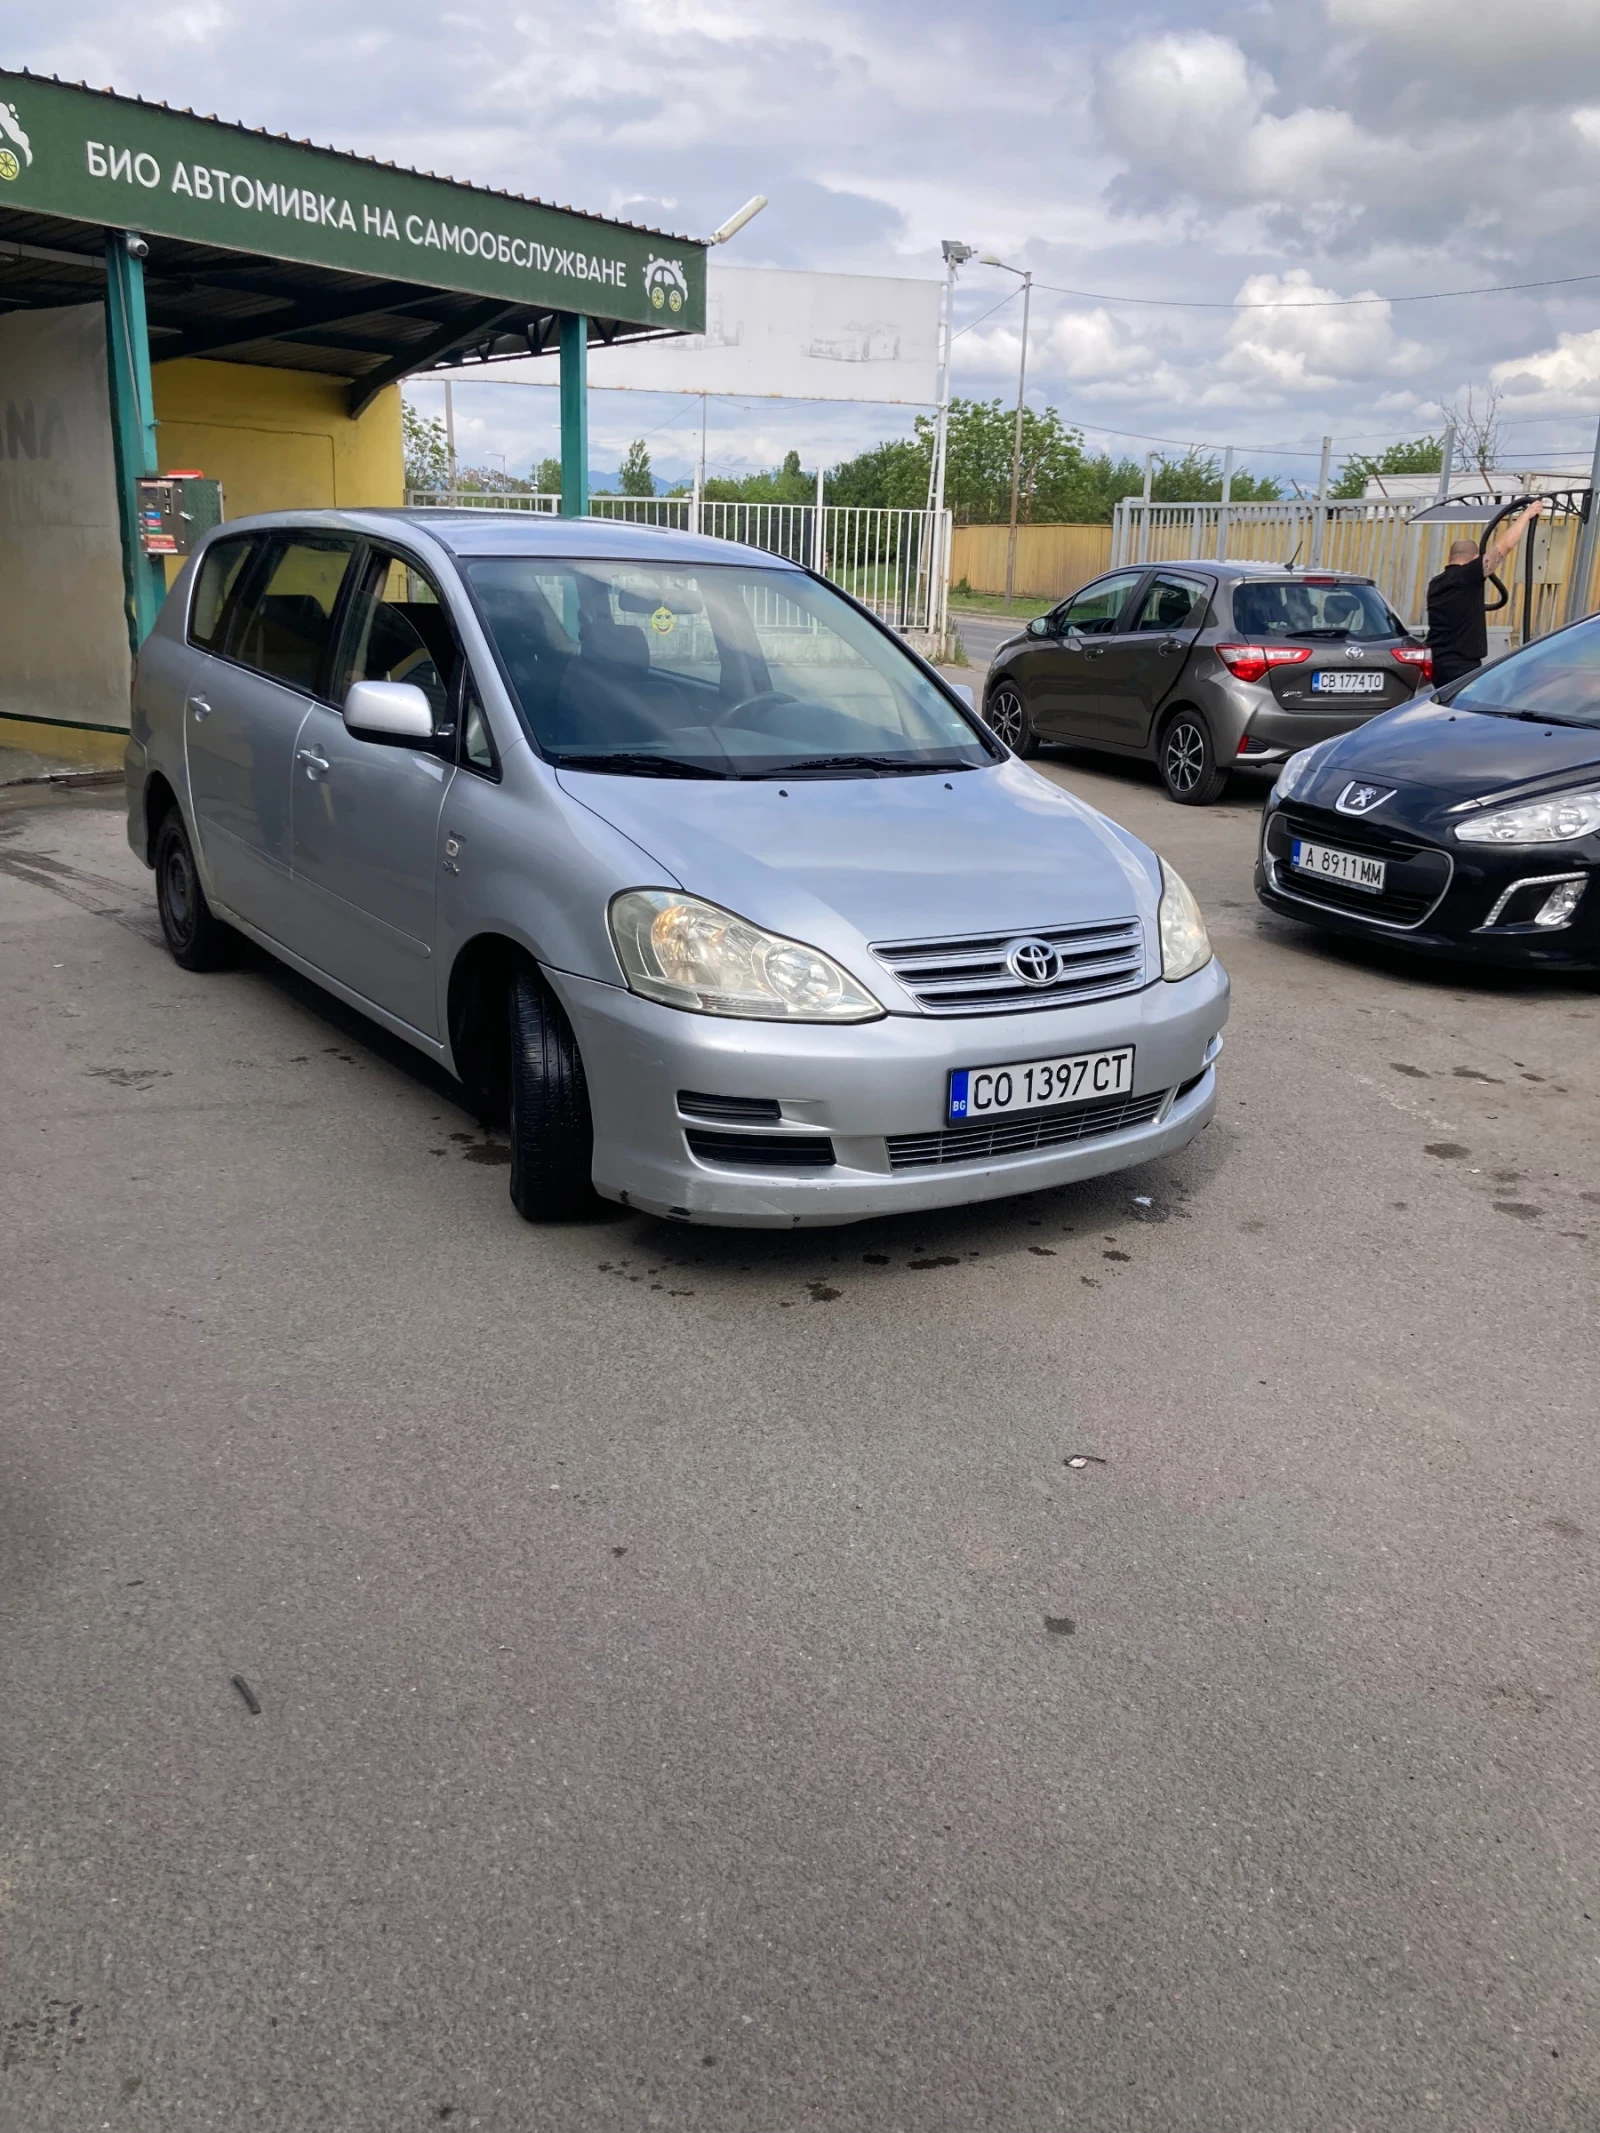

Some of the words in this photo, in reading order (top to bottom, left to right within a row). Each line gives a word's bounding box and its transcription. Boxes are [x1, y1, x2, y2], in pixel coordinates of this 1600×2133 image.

[86, 140, 161, 188] БИО
[171, 161, 357, 232] АВТОМИВКА
[363, 204, 400, 241] НА
[405, 215, 627, 288] САМООБСЛУЖВАНЕ
[1321, 674, 1336, 688] CB
[1339, 674, 1365, 688] 1774
[1305, 847, 1314, 868] A
[952, 1100, 966, 1111] BG
[973, 1072, 1013, 1110] CO
[1023, 1060, 1089, 1102] 1397
[1093, 1053, 1128, 1092] CT
